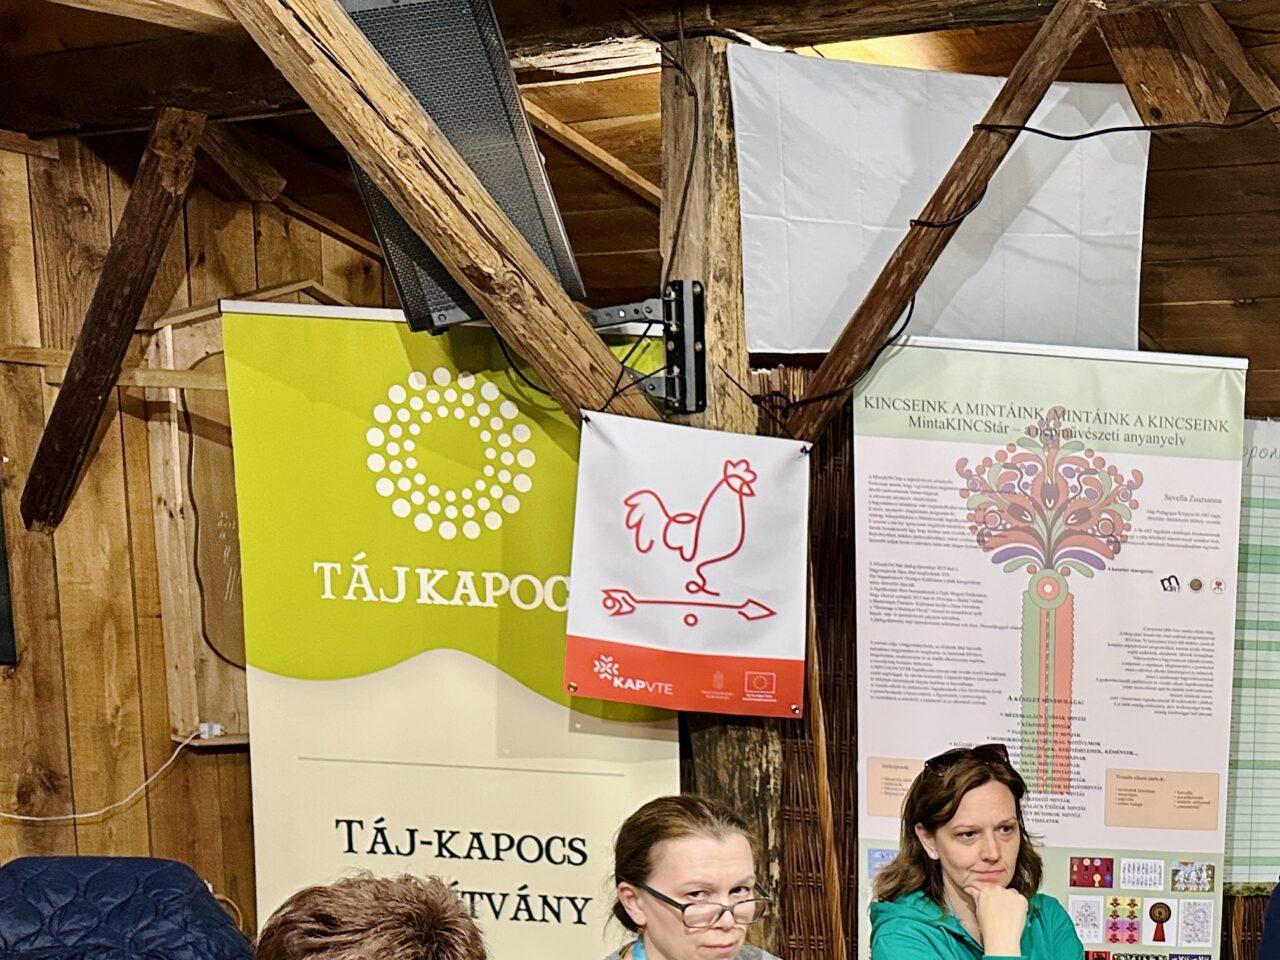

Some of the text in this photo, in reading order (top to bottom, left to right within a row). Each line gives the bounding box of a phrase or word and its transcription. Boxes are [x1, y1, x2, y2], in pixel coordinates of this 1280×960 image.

[864, 396, 948, 414] KINCSEINK
[952, 402, 962, 414] A
[1054, 408, 1130, 427] MINTÁINK
[1134, 415, 1144, 428] A
[1148, 415, 1230, 433] KINCSEINK
[908, 415, 1009, 434] MintaKINCStár
[1123, 433, 1187, 448] anyanyelv
[313, 551, 571, 612] TÁJ KAPOC
[613, 676, 674, 695] KAPVTE
[335, 816, 589, 866] TÁJ-KAPOCS
[450, 880, 593, 926] TVÁNY
